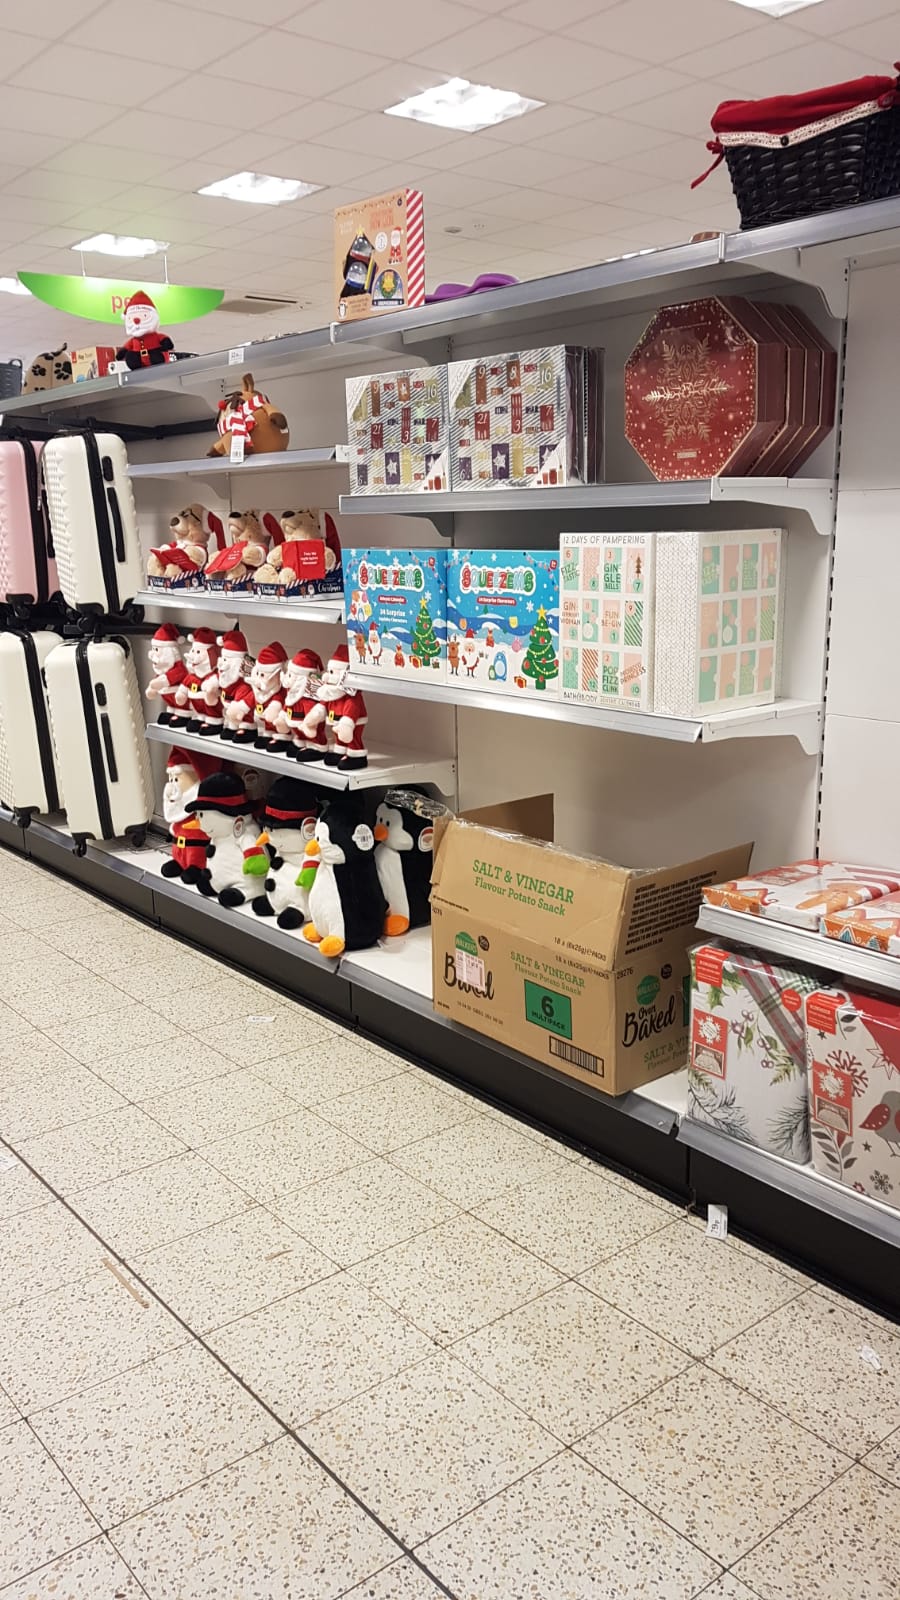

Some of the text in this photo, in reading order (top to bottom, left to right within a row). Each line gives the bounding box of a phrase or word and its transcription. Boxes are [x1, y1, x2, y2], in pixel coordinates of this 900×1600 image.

[478, 366, 486, 379] 9
[509, 366, 517, 380] 8
[541, 367, 552, 384] 16
[477, 414, 488, 425] 21
[514, 420, 521, 432] 3
[373, 425, 381, 435] 21
[402, 431, 409, 442] 3
[563, 535, 646, 544] 12 DAYS OF PAMPERING
[566, 550, 571, 558] 6
[360, 564, 423, 589] SQUEEZEMS
[462, 566, 534, 592] SQUEEZEMS
[604, 573, 621, 583] GLE
[636, 582, 641, 591] 7
[386, 609, 405, 617] Surprise
[605, 610, 619, 619] FUN
[603, 665, 619, 675] POP
[602, 675, 619, 685] FIZZ
[472, 859, 575, 904] SALT & VINEGAR
[474, 876, 566, 916] Flavour Potato Snack
[554, 936, 561, 945] 18
[511, 951, 586, 988] SALT & VINEGAR
[562, 982, 582, 996] Snack
[541, 995, 555, 1018] 6
[638, 1005, 656, 1020] Oven
[531, 1010, 566, 1030] MULTIPACK
[622, 994, 676, 1048] Baked
[644, 1043, 668, 1063] SALT
